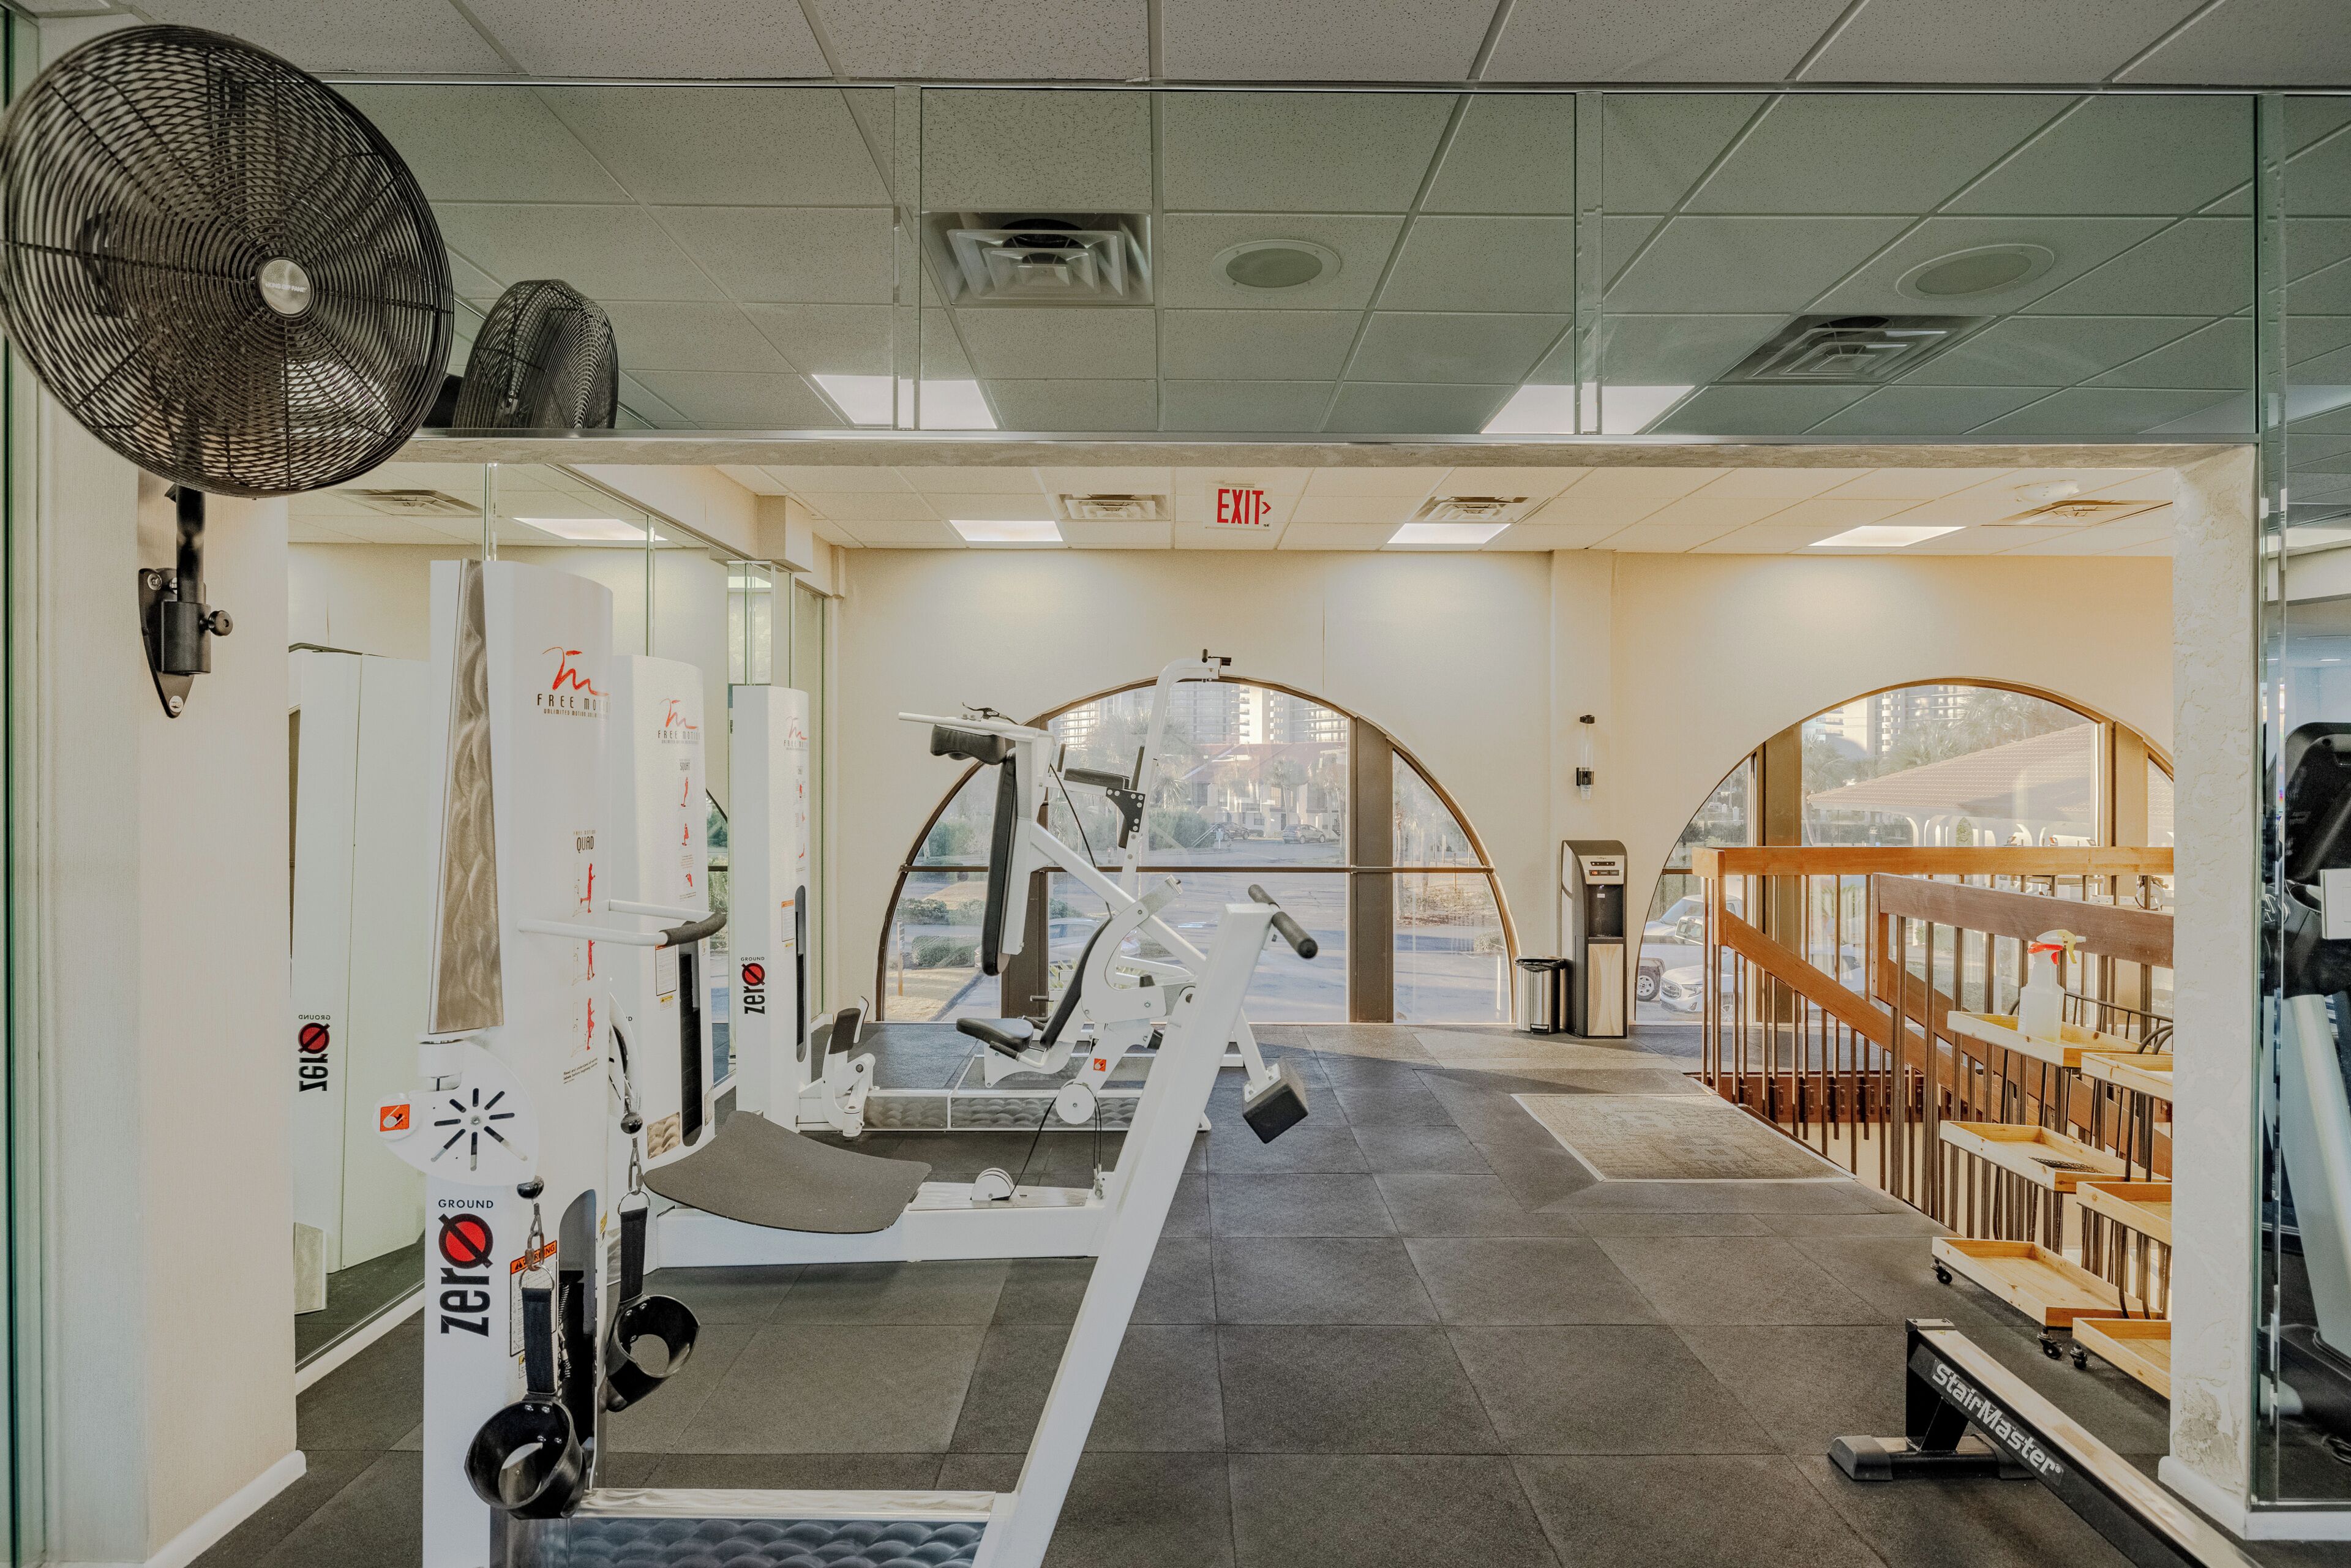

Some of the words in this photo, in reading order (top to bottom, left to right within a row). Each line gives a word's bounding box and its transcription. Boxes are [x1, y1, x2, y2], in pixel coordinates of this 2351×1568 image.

[1217, 489, 1264, 525] EXIT
[537, 693, 574, 708] FREE
[658, 730, 677, 739] FREE
[577, 836, 594, 853] QUAD
[438, 1199, 493, 1209] GROUND
